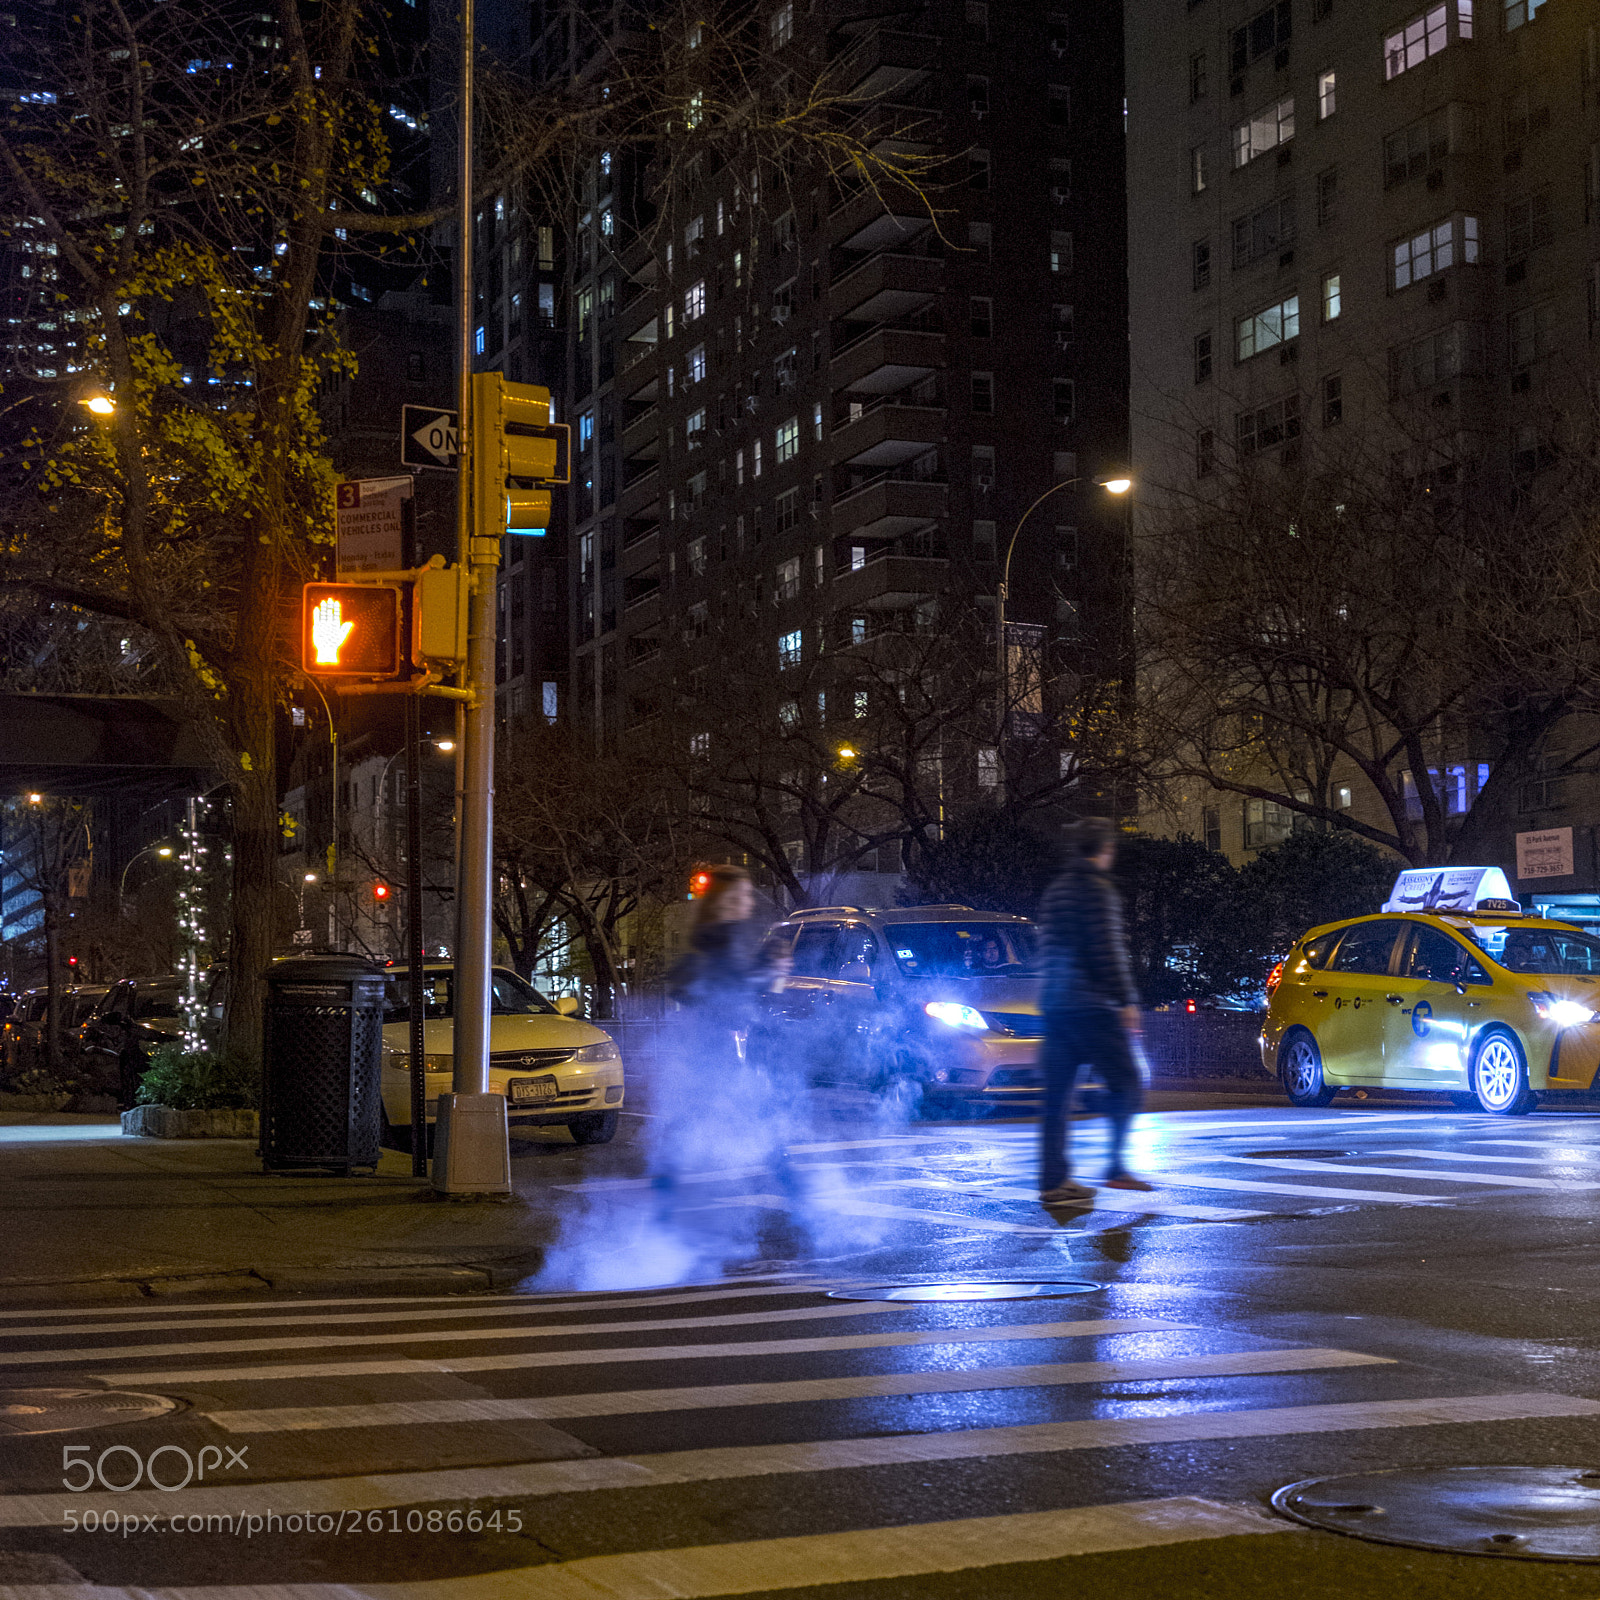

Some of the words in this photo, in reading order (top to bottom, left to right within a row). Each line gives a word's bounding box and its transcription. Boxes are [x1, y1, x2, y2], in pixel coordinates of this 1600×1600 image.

[430, 428, 459, 452] ON
[343, 485, 355, 507] 3
[340, 511, 396, 525] COMMERCIAL
[340, 524, 382, 536] VEHICLES
[383, 522, 401, 533] ONL
[1487, 899, 1507, 909] 7V25
